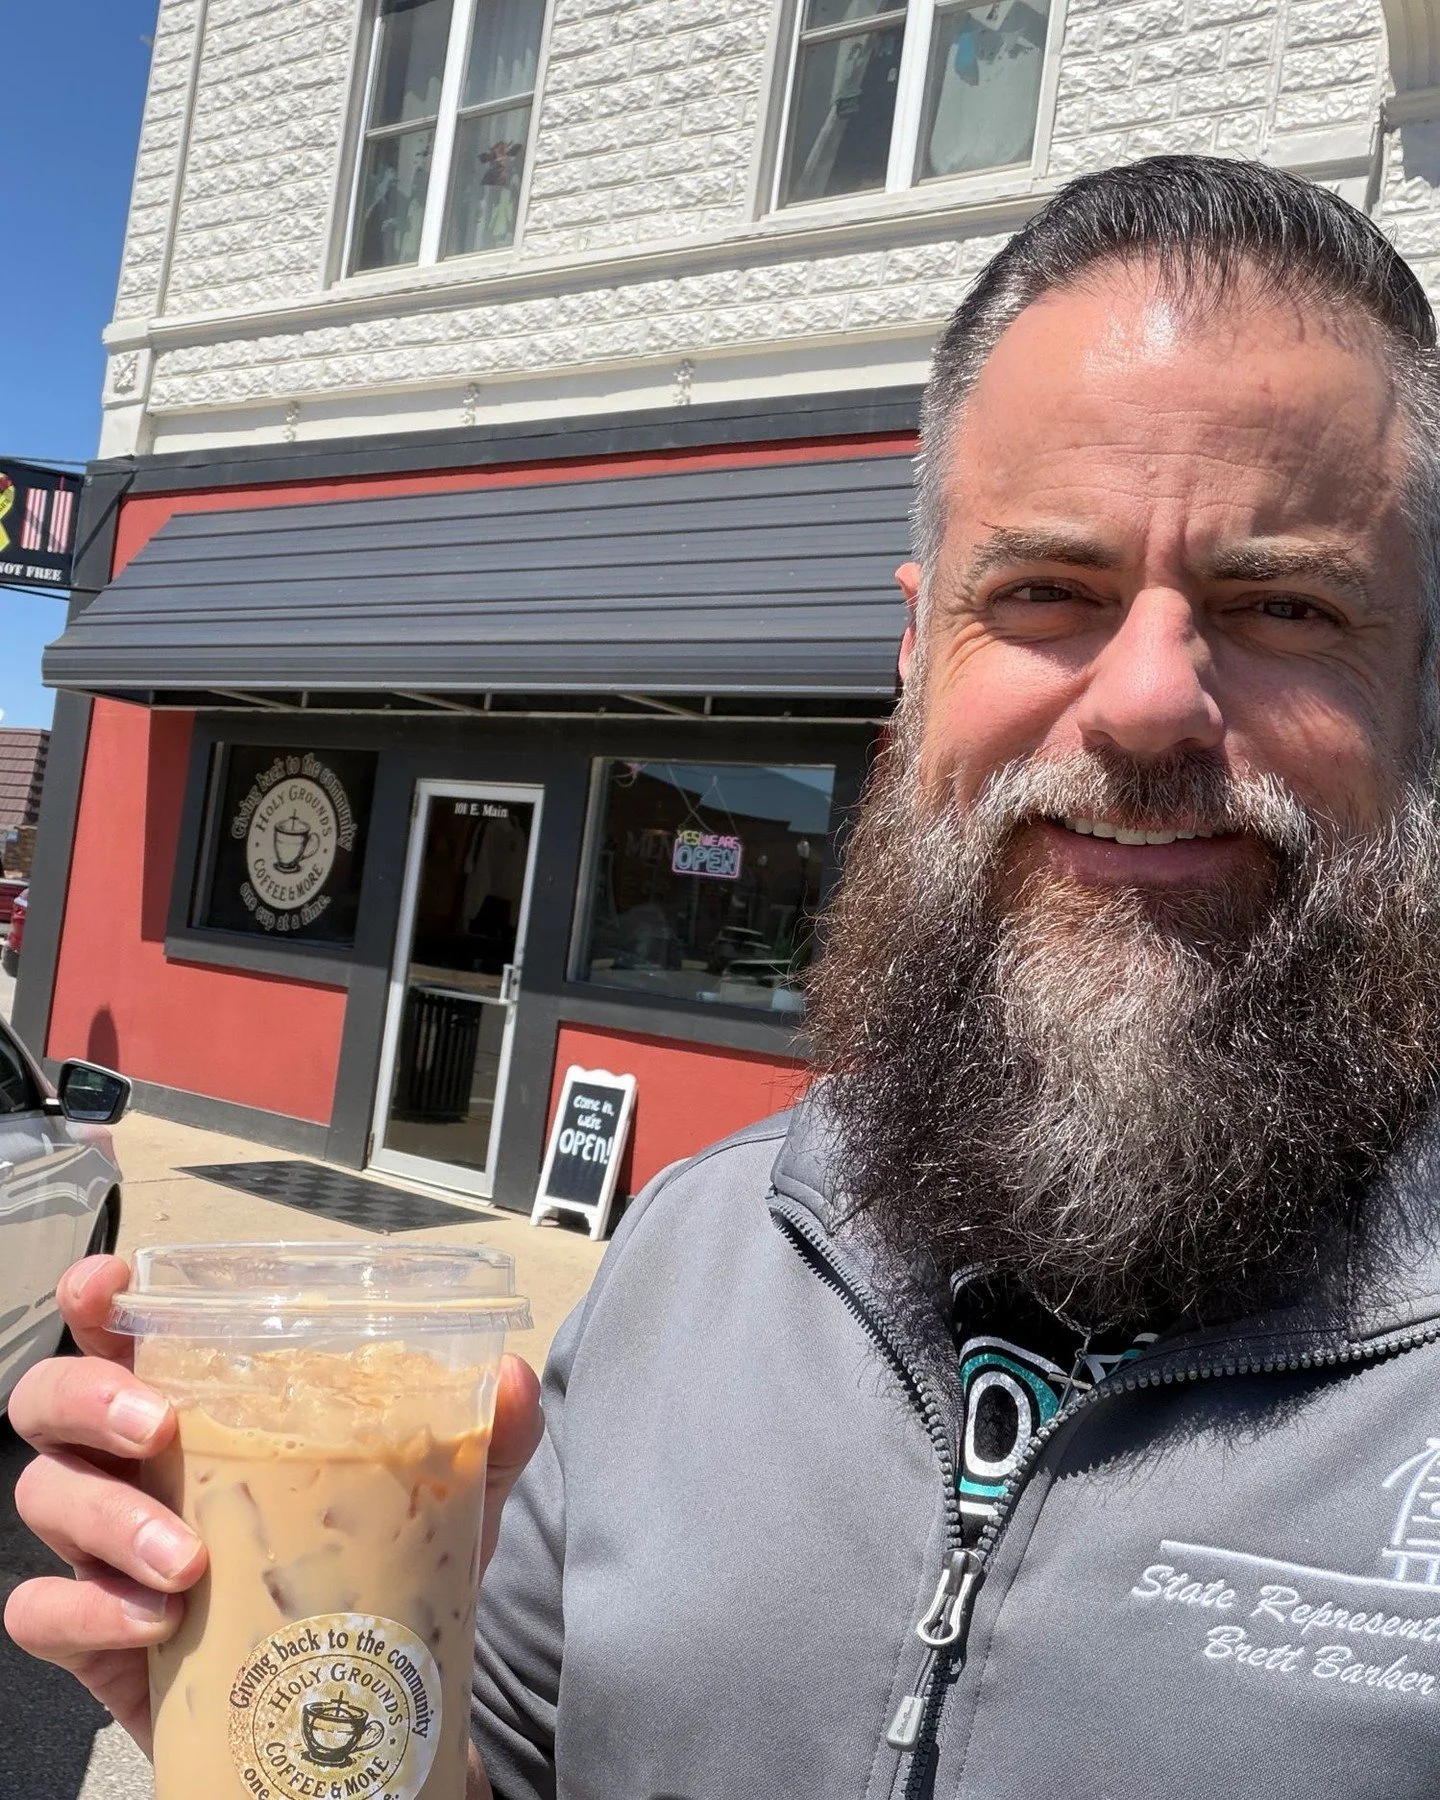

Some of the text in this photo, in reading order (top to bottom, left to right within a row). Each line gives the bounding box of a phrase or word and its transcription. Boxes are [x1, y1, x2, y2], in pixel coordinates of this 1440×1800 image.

[26, 566, 62, 582] FREE
[231, 752, 358, 851] Giving back to the community
[255, 785, 332, 837] HOLY GROUNDS
[454, 802, 467, 815] 101
[482, 804, 509, 818] Main
[675, 845, 738, 875] OPEN
[239, 881, 258, 912] one
[255, 906, 276, 931] cup
[276, 912, 289, 931] at
[290, 914, 300, 930] a
[1131, 1564, 1440, 1644] State Represent
[229, 1628, 435, 1739] Giving back to the community
[1203, 1625, 1436, 1695] Brett Barker
[268, 1662, 403, 1727] HOLY GROUNDS
[243, 1767, 270, 1800] one
